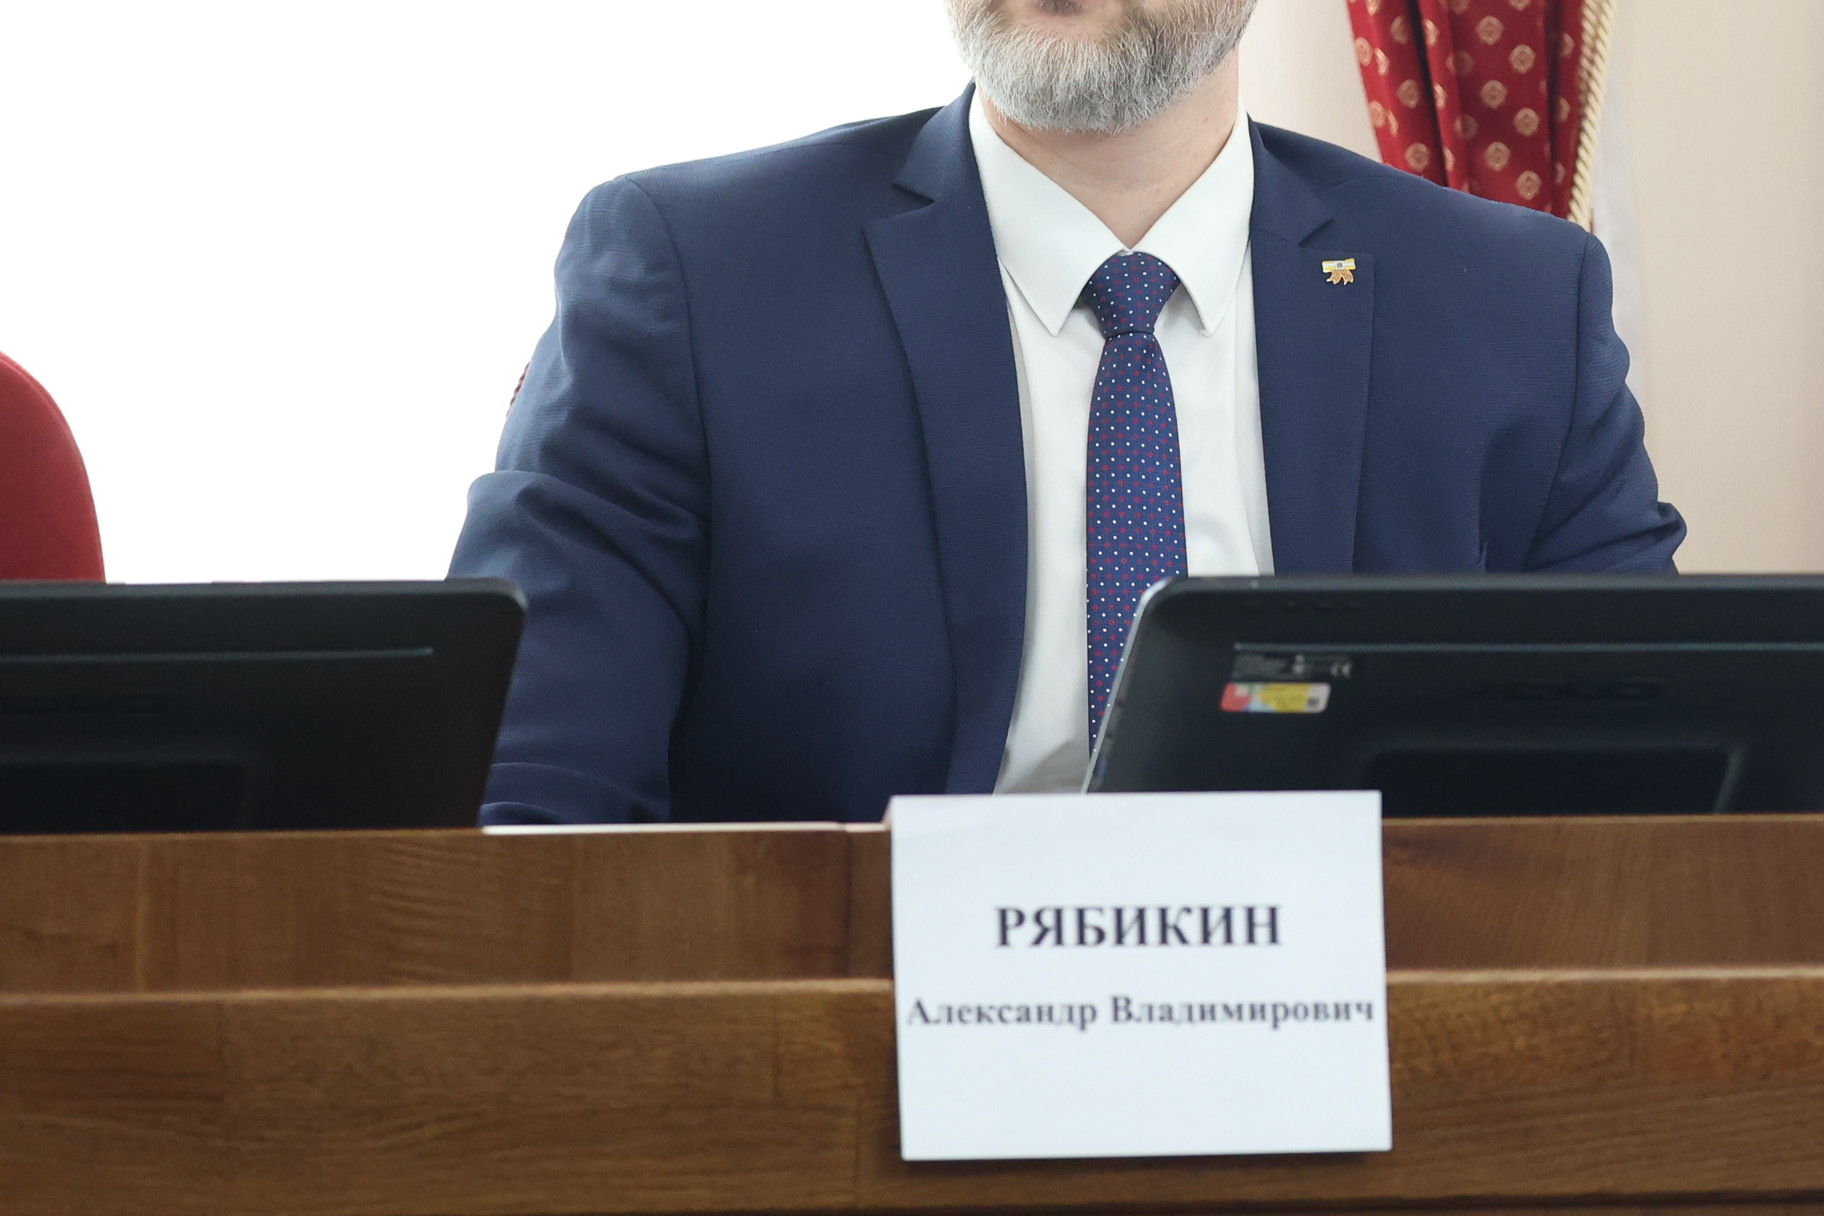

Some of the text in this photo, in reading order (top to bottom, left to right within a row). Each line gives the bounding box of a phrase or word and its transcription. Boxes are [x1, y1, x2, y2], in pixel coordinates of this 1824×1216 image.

[995, 904, 1281, 948] РЯБИКИН
[908, 994, 1374, 1033] Александр Владимирович
